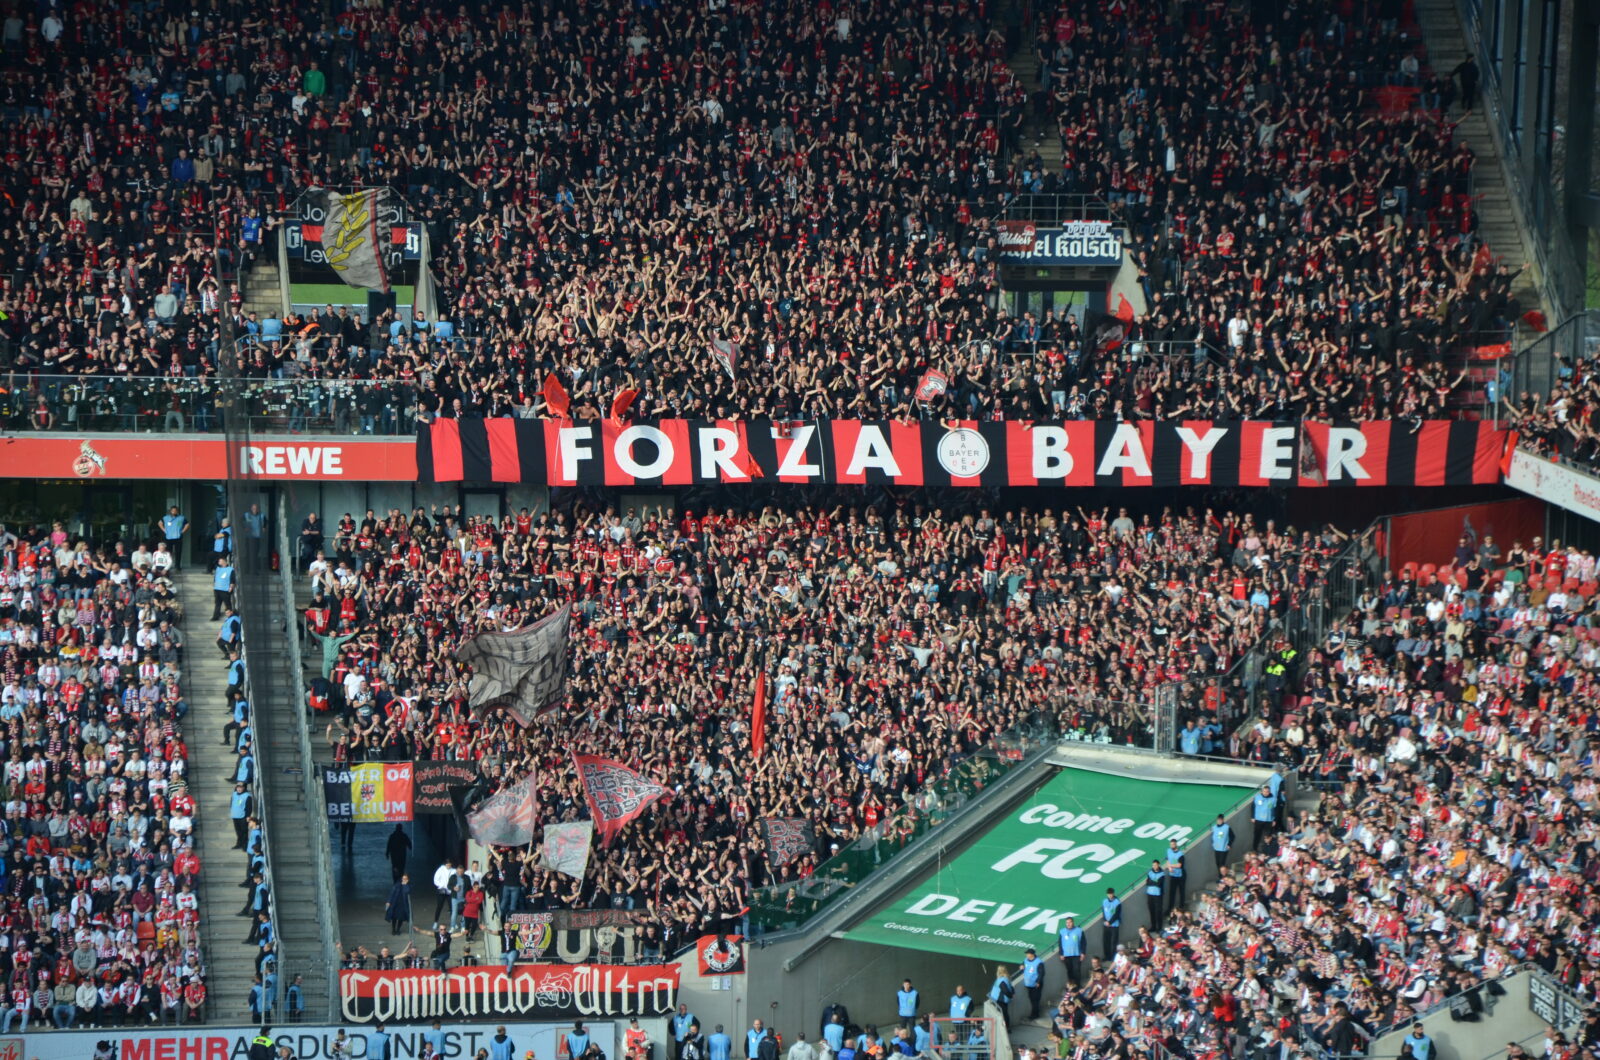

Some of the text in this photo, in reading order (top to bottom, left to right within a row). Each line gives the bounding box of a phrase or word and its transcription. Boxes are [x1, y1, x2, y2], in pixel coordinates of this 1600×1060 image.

[240, 446, 343, 475] REWE
[560, 424, 1371, 479] FORZA BAYER
[326, 768, 382, 784] BAYER
[386, 767, 410, 782] 04
[327, 801, 407, 816] BELGIUM
[1019, 803, 1136, 834] Come
[991, 837, 1147, 884] FC!
[904, 893, 1080, 935] DEVK
[883, 922, 1036, 950] Gesagt. Getan. Geholfen.
[341, 972, 535, 1023] Commando
